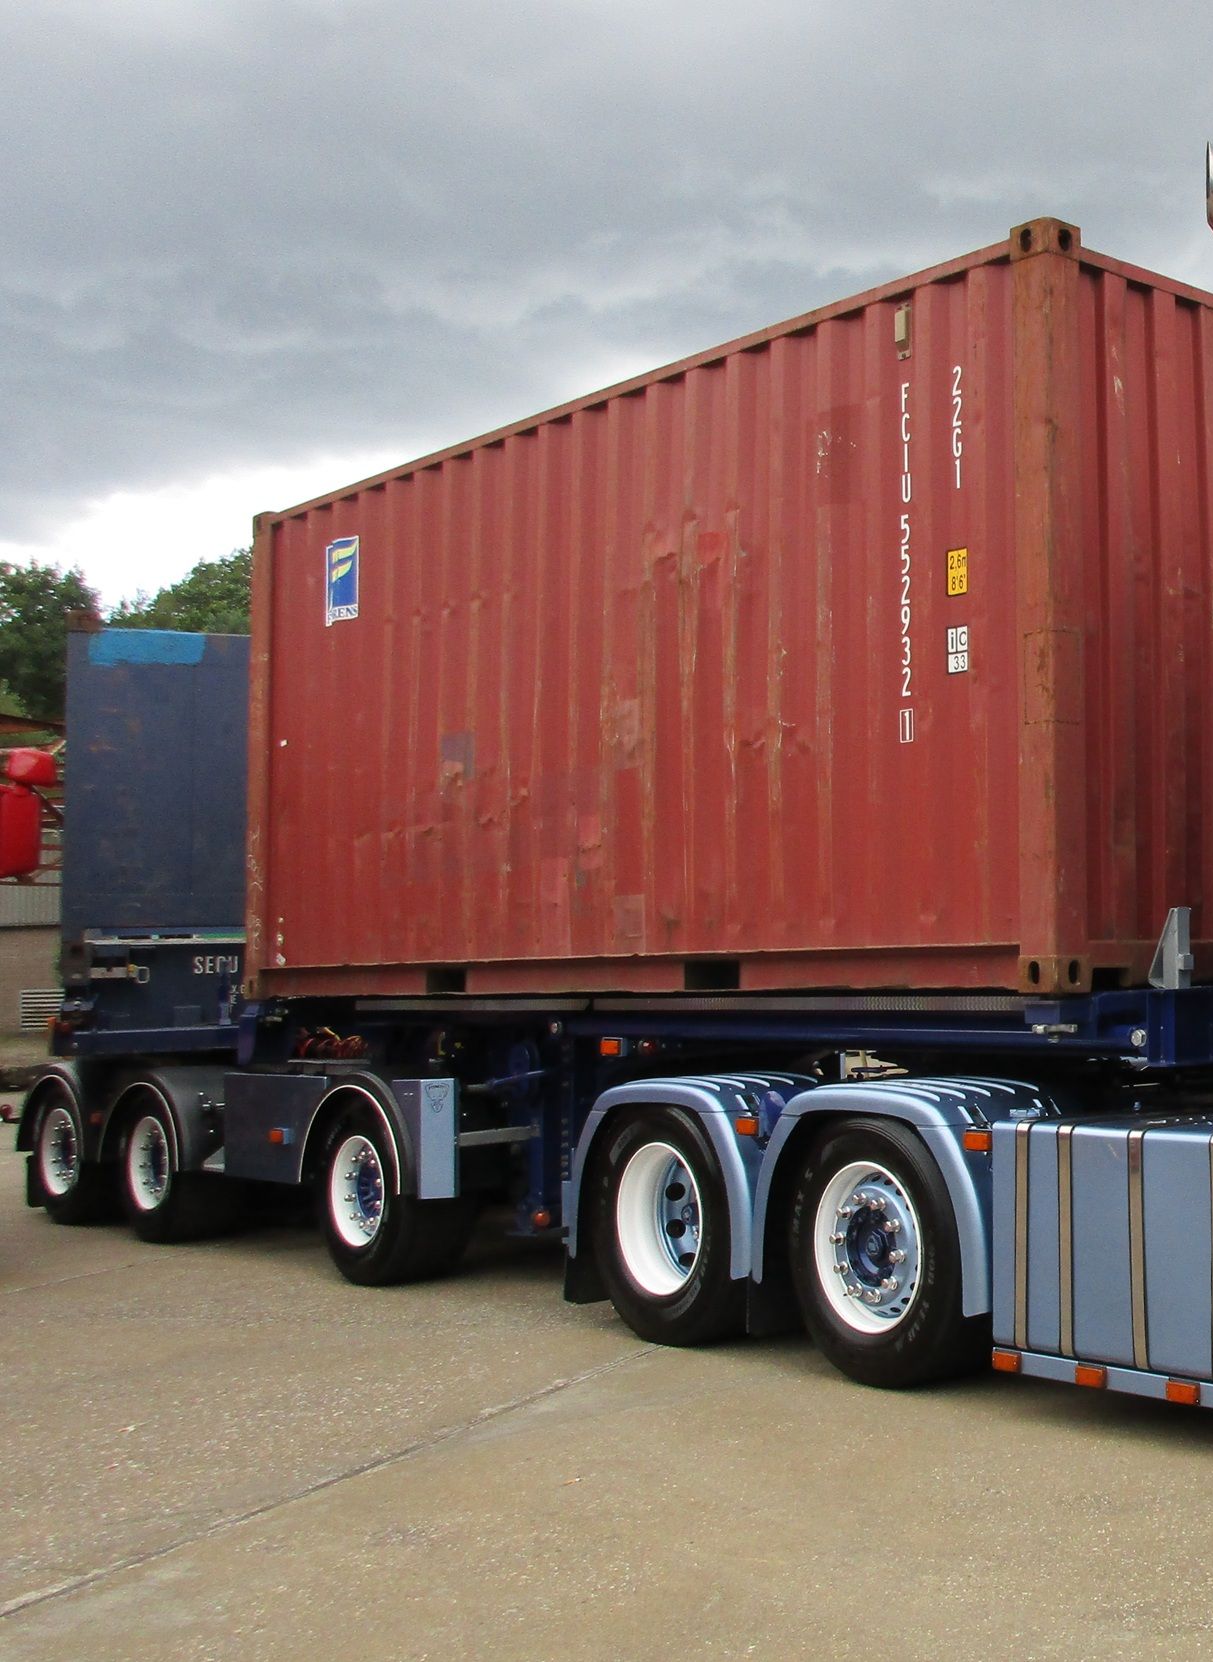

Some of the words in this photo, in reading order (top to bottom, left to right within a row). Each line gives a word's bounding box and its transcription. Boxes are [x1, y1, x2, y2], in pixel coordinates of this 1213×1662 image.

[900, 382, 912, 504] FCIU
[951, 366, 962, 489] 22G1
[900, 513, 912, 698] 552932
[953, 654, 966, 671] 33
